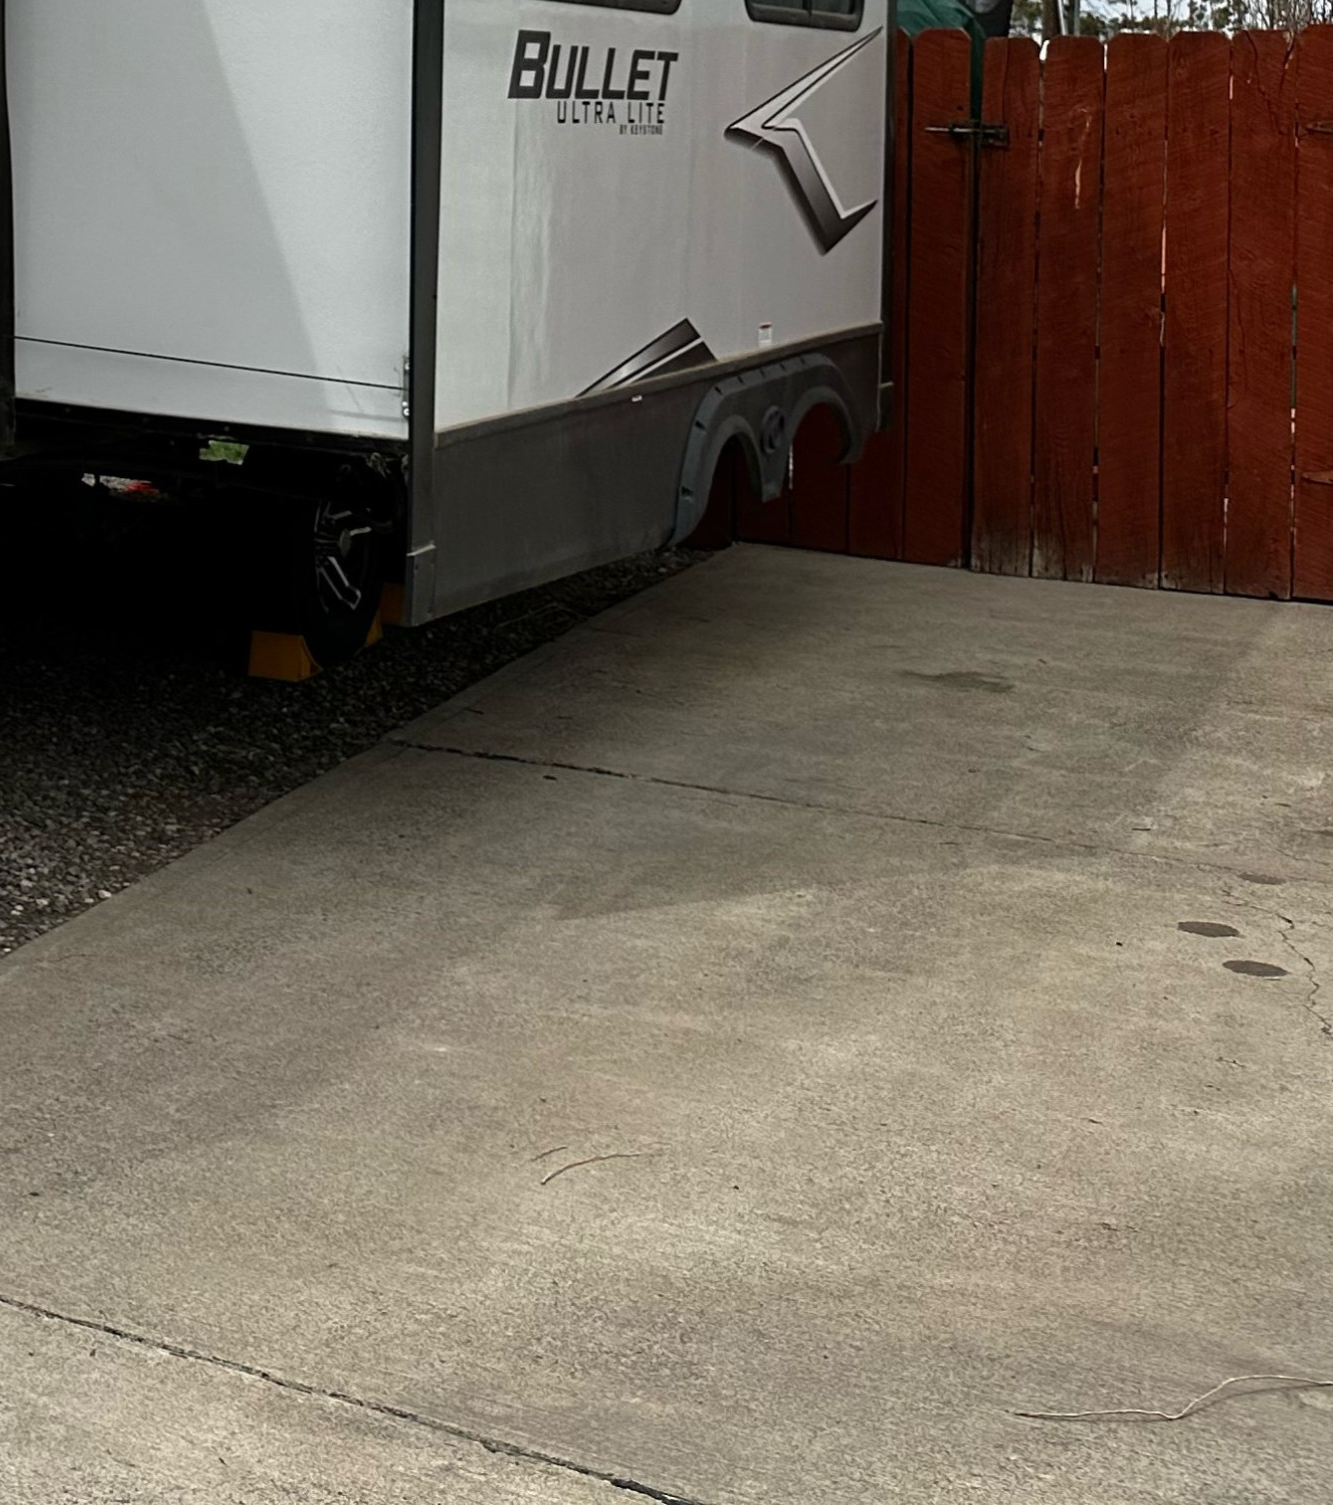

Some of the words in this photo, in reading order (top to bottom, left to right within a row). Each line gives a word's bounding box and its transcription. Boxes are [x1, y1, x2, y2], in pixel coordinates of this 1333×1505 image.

[508, 29, 679, 100] BULLET
[557, 101, 616, 124] ULTRA
[628, 102, 665, 124] LITE
[619, 125, 628, 134] BY
[630, 125, 664, 135] KEYSTONE
